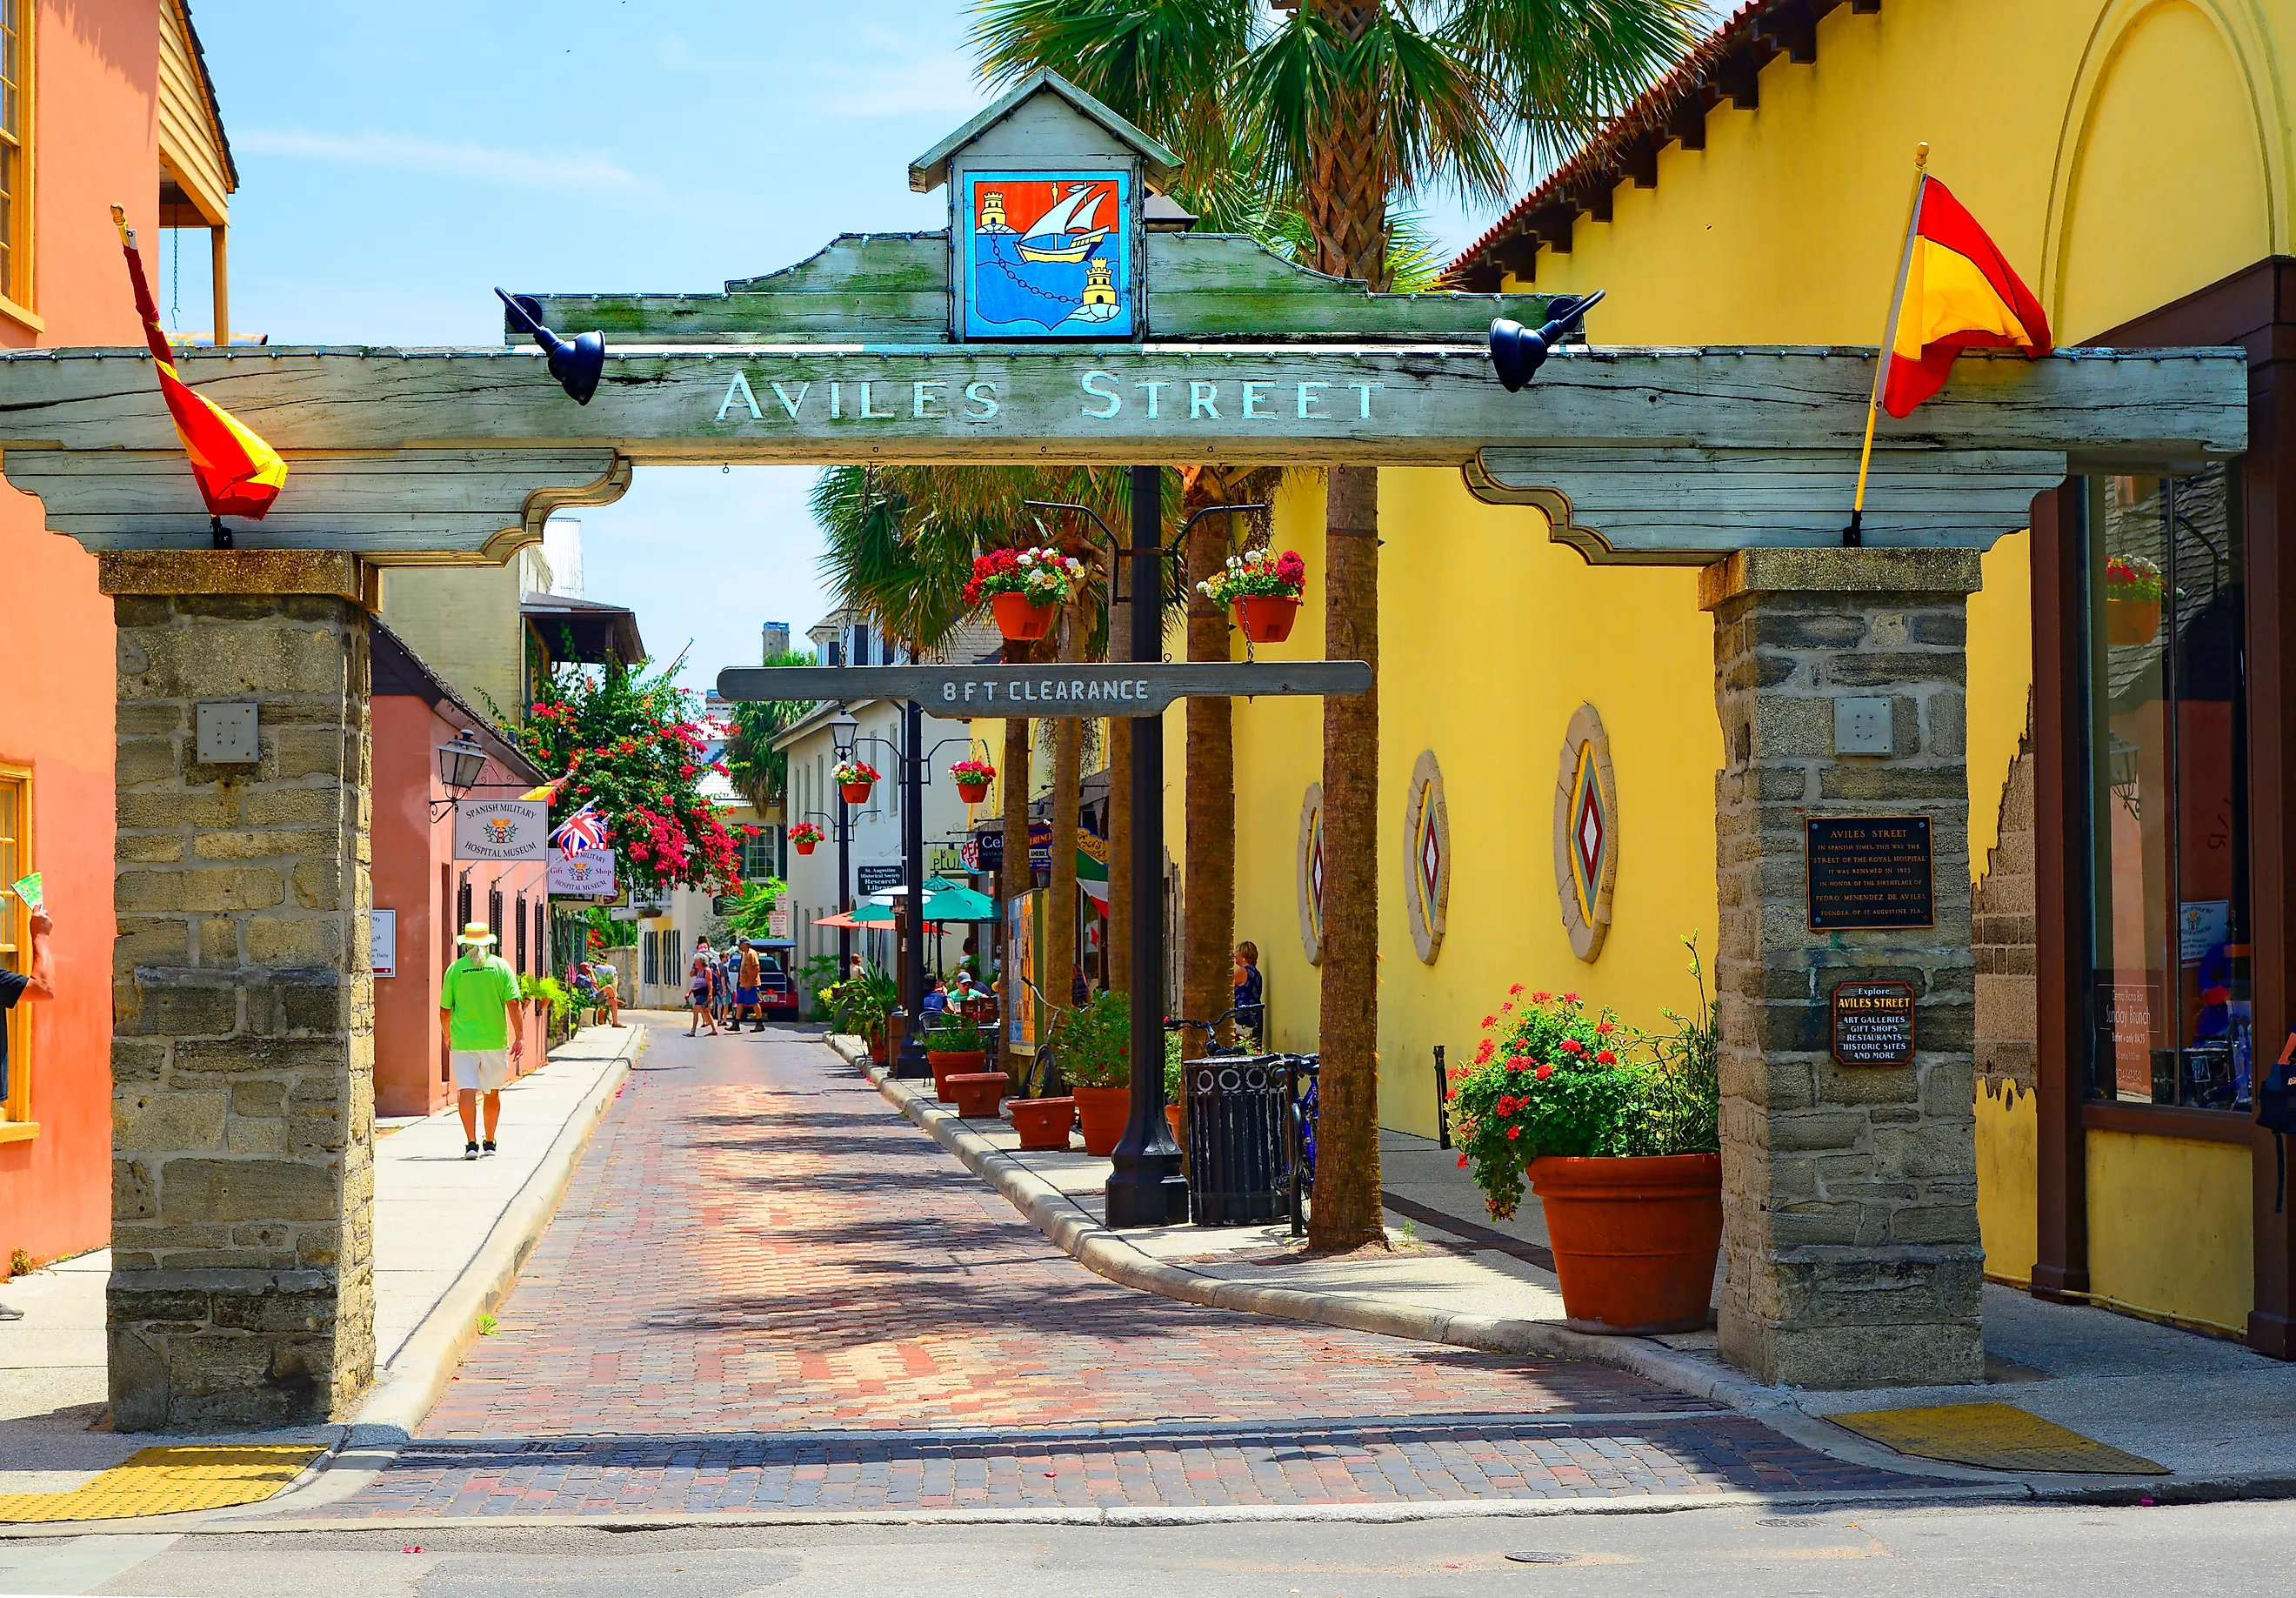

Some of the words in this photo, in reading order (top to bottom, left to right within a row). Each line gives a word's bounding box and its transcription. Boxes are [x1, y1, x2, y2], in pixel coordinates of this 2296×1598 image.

[714, 370, 1000, 421] AVILES
[1081, 370, 1385, 420] STREET
[1009, 680, 1149, 701] CLEARANCE
[465, 804, 498, 819] SPANISH
[499, 803, 537, 819] MILITARY
[1831, 830, 1866, 839] AVILES
[1872, 829, 1907, 838] STREET
[464, 840, 502, 858] HOSPITAL
[503, 841, 537, 858] MUSEUM
[554, 879, 581, 891] HOSPITAL
[582, 879, 606, 891] MUSEUM
[1858, 987, 1890, 996] Explore
[1838, 998, 1872, 1008] AVILES
[1873, 998, 1911, 1007] STREET
[2106, 1004, 2128, 1027] Sunday
[2129, 1005, 2151, 1025] Brunch
